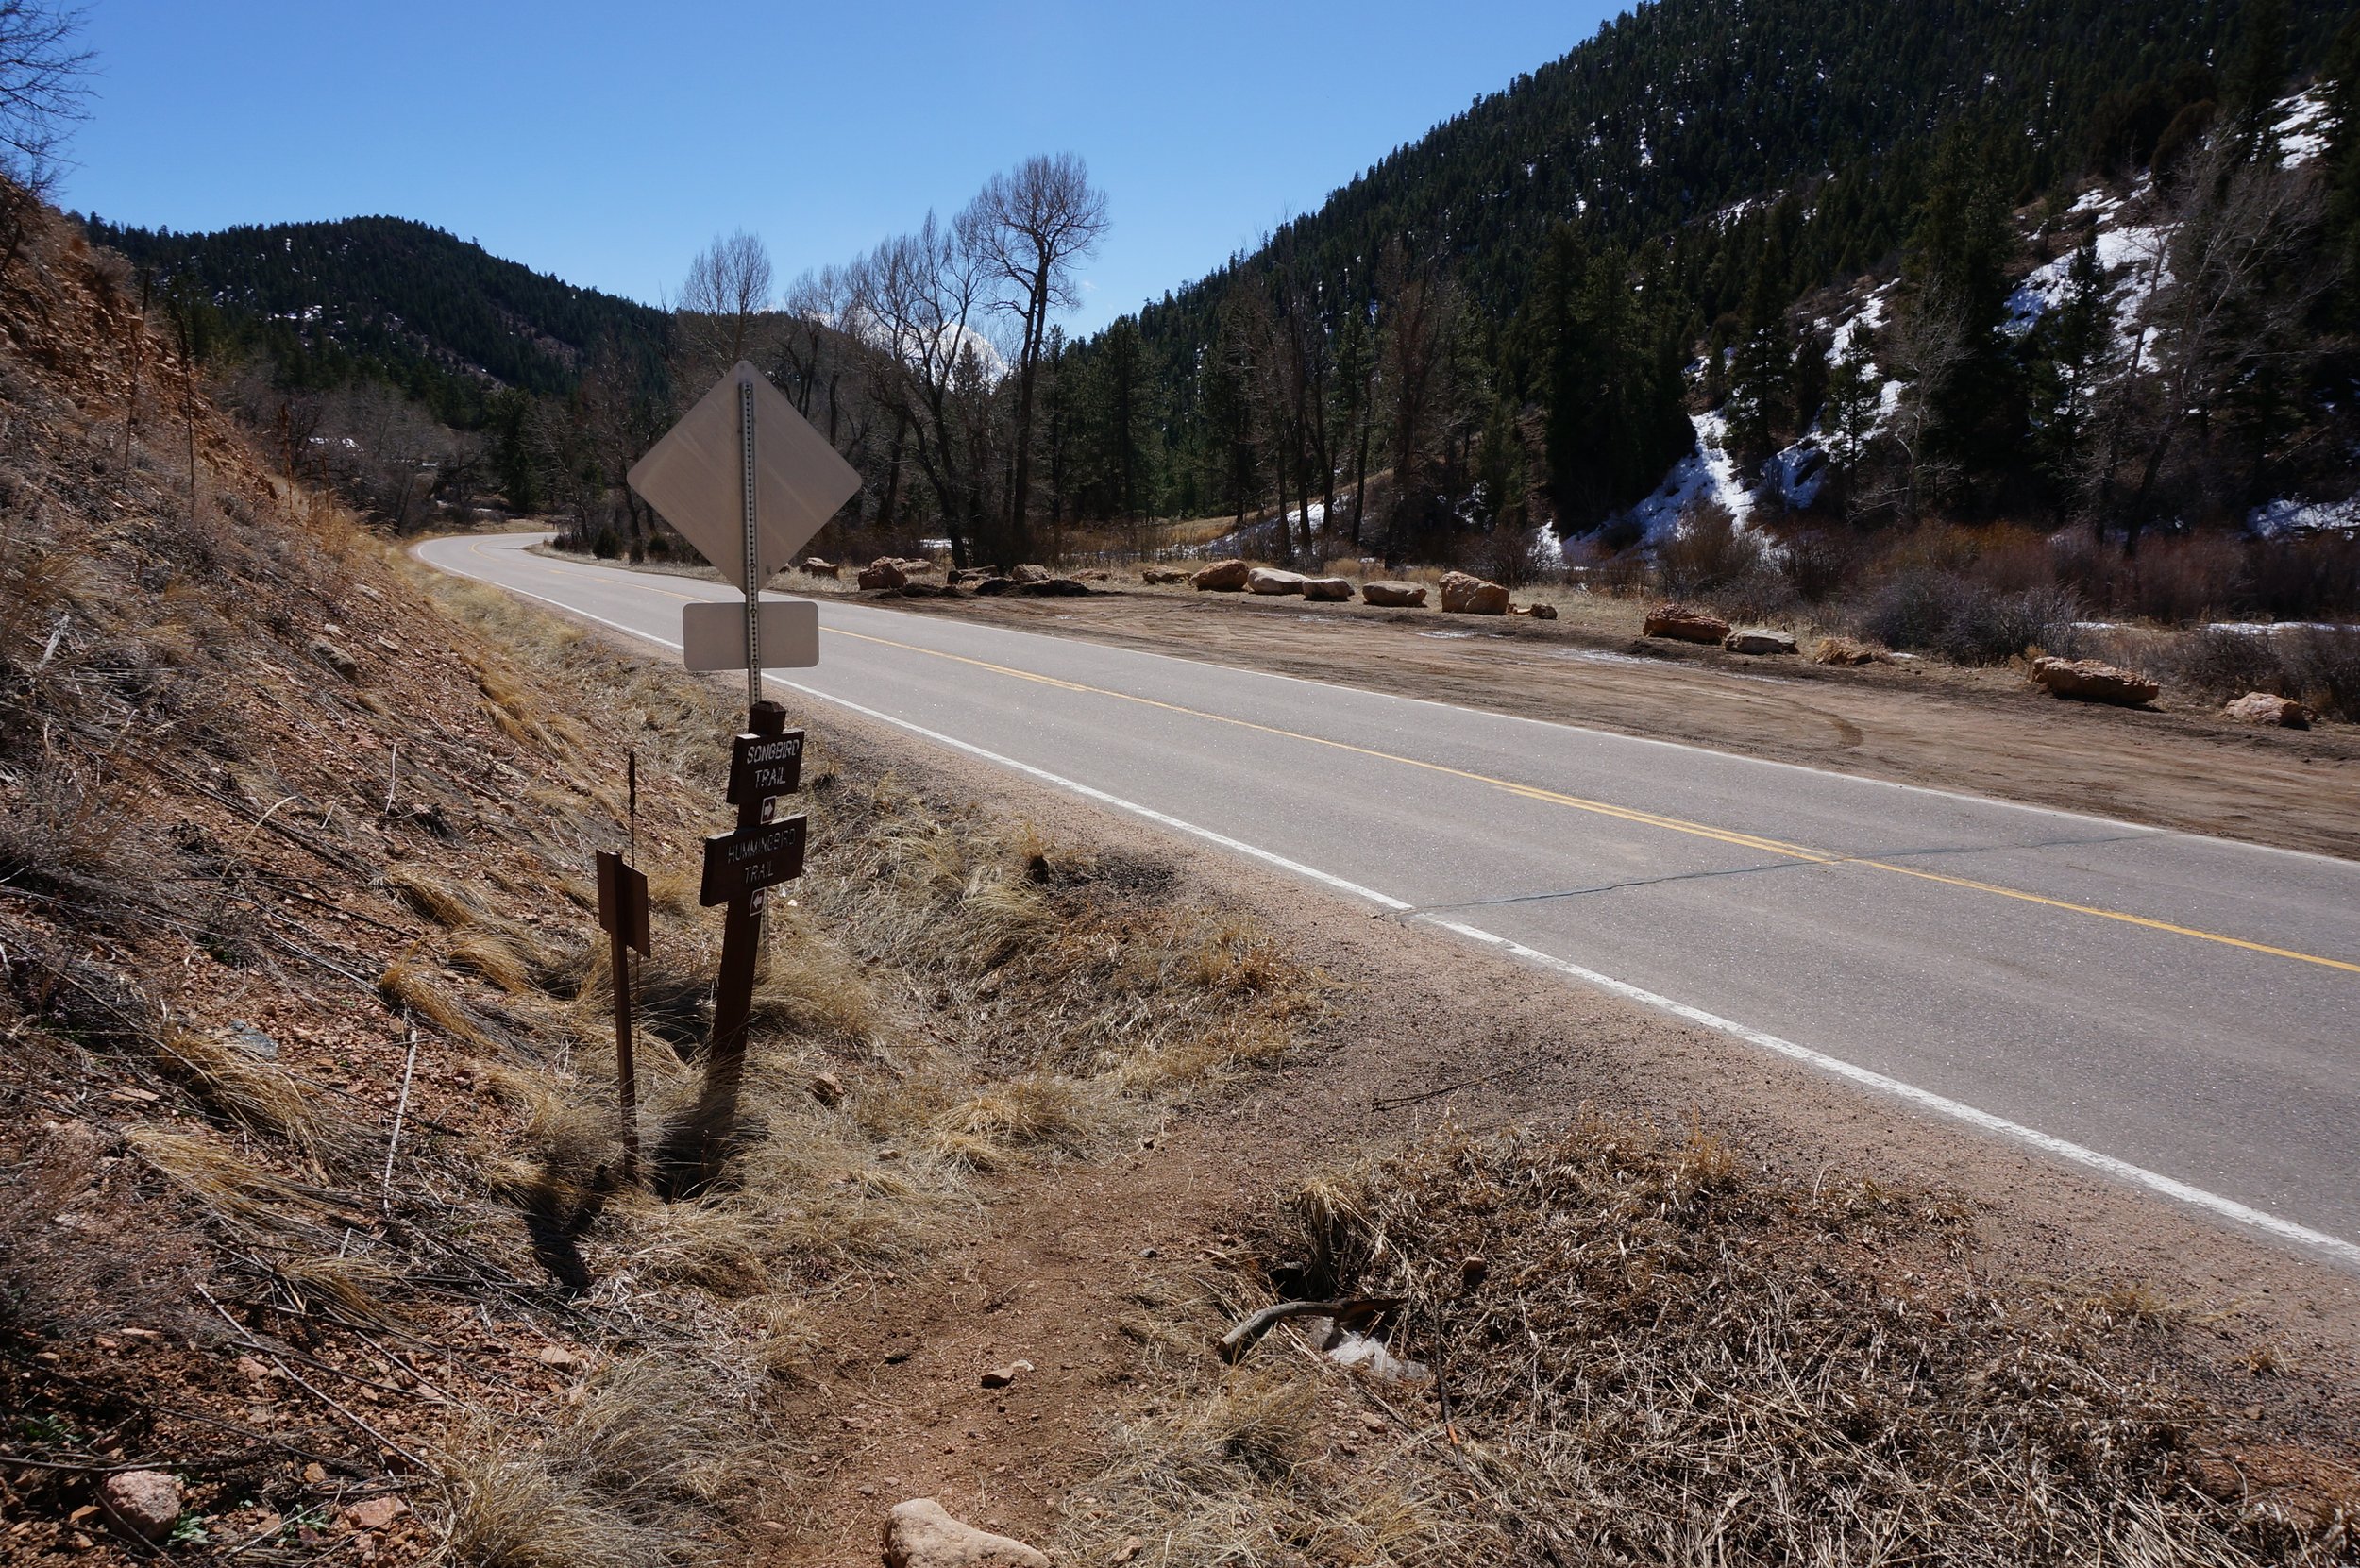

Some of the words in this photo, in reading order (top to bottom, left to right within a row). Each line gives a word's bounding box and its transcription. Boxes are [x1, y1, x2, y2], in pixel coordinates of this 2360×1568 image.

[747, 739, 800, 764] SONGBIRD
[755, 767, 786, 788] TRAIL
[726, 827, 796, 865] HUMMINGBIRD
[745, 861, 774, 884] TRAIL
